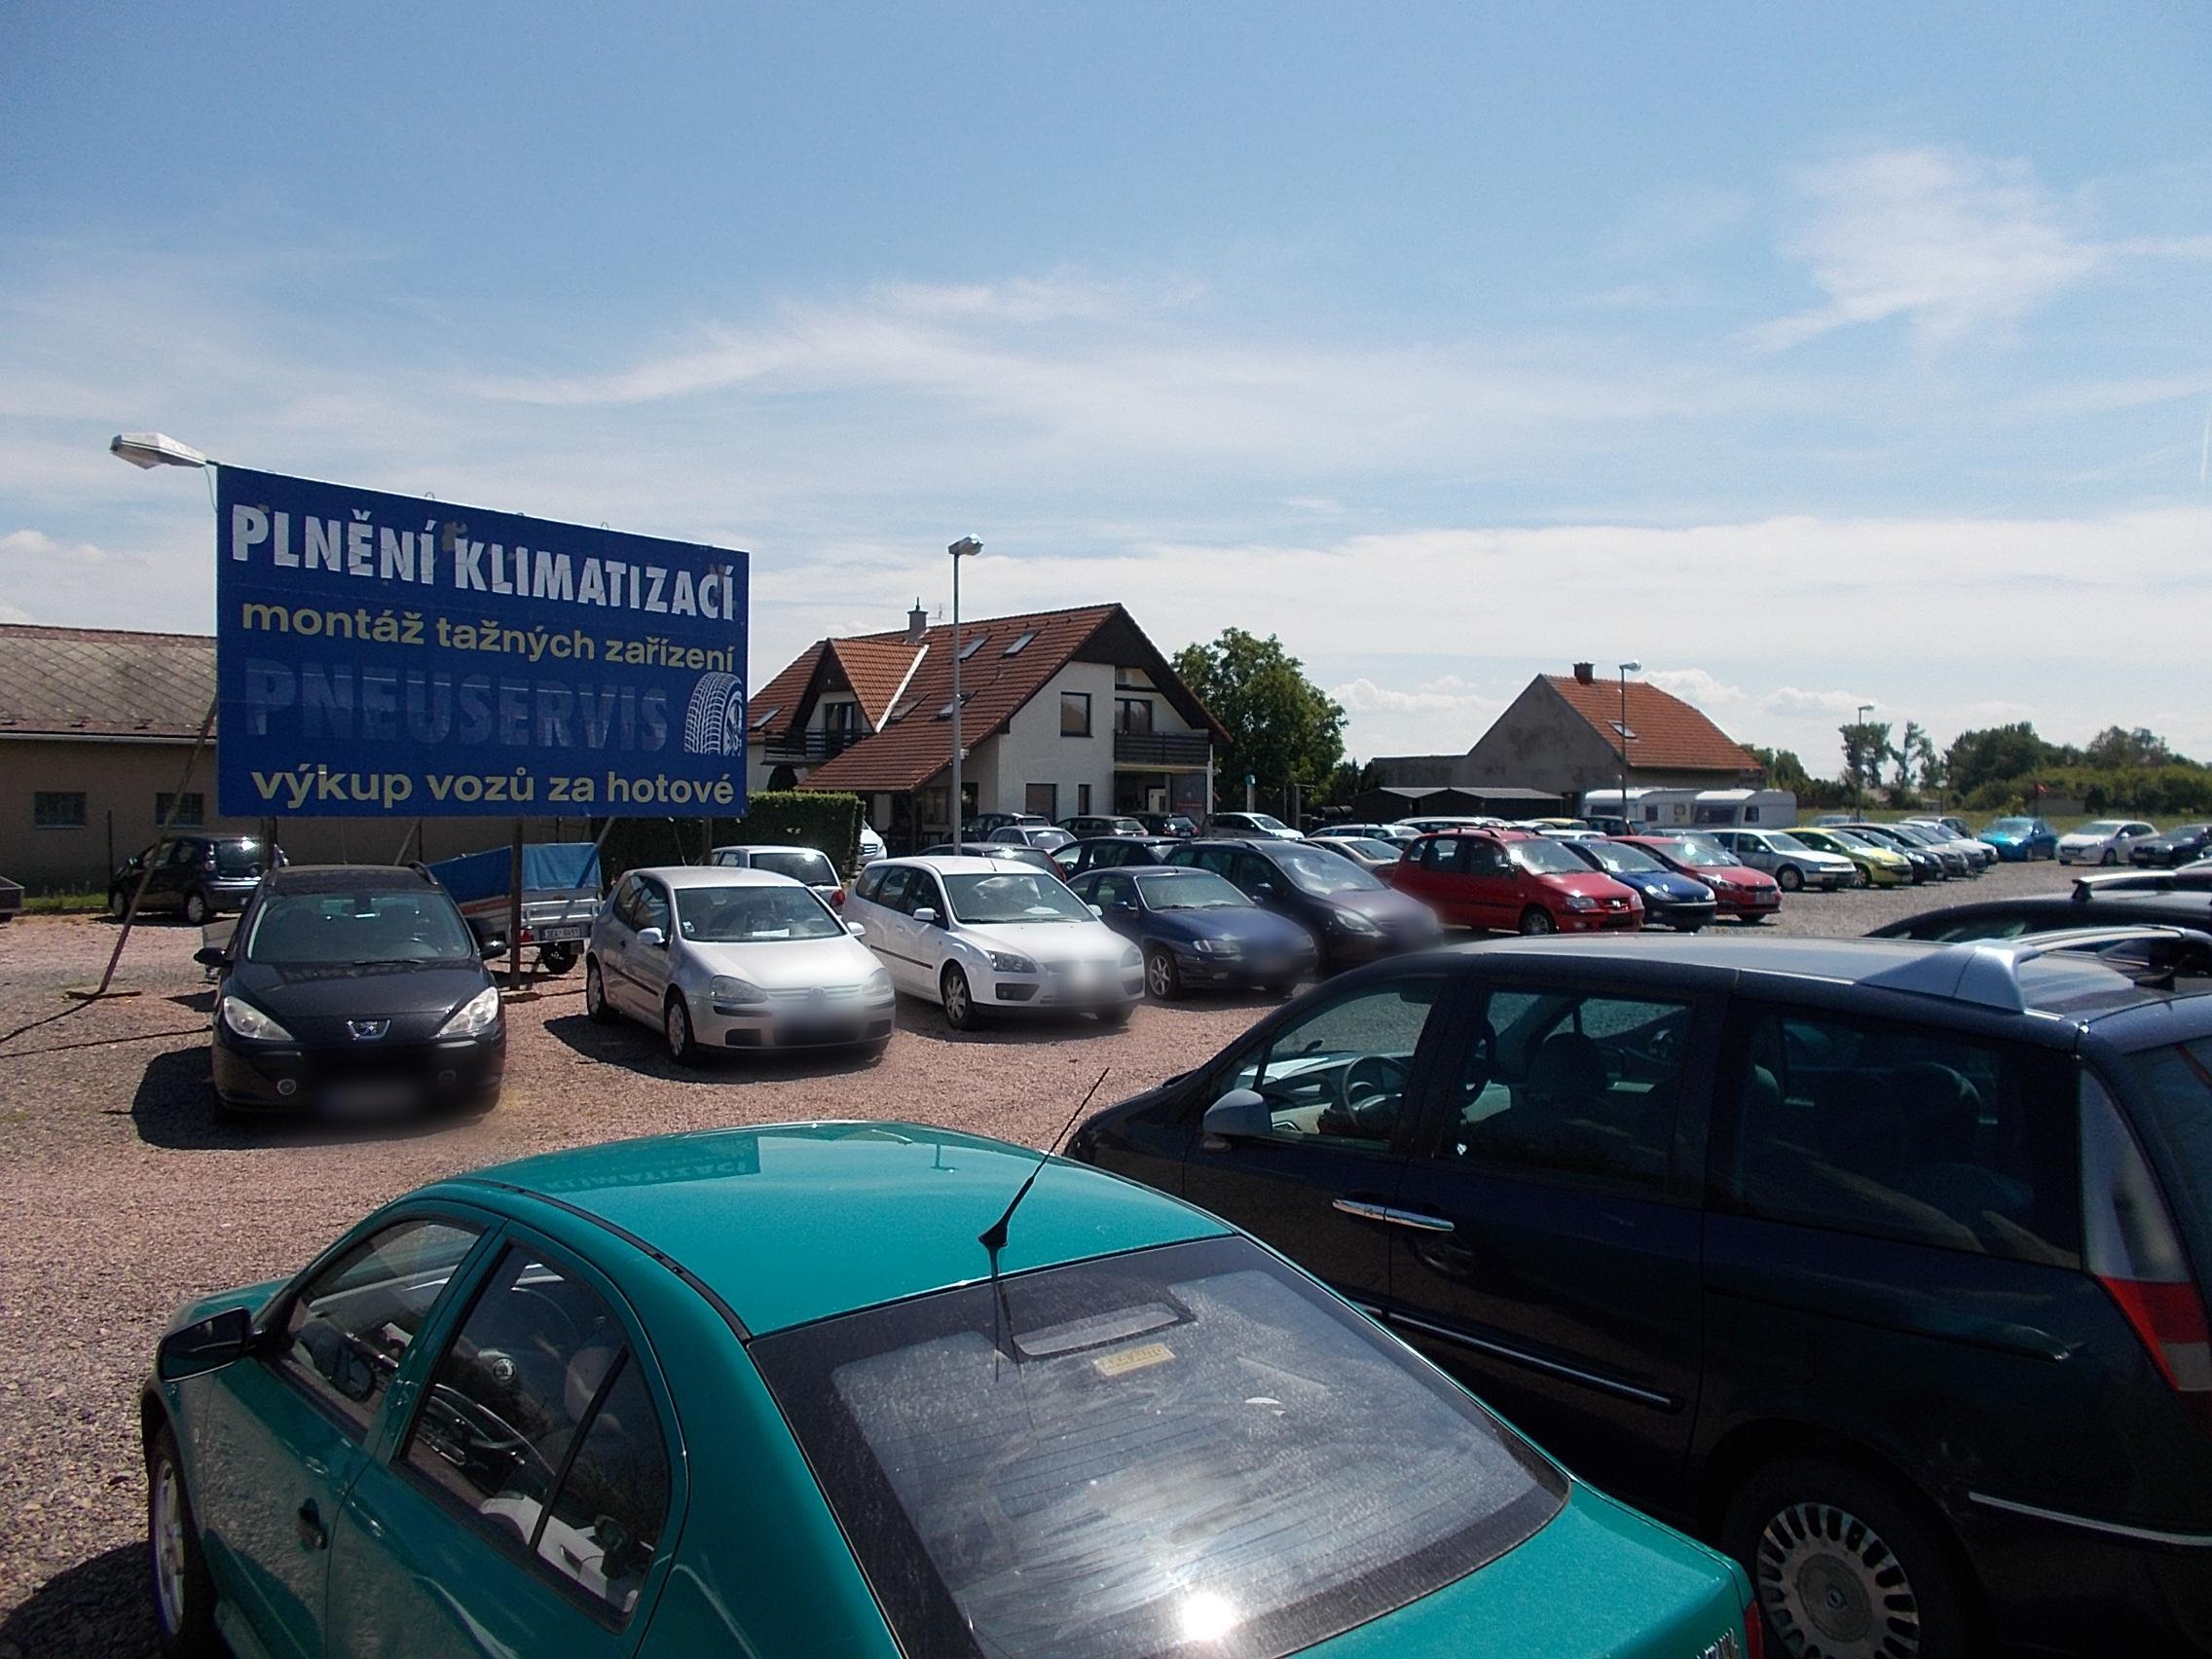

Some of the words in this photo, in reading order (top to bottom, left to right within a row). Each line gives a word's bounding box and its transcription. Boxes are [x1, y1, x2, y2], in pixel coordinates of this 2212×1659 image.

[232, 503, 437, 585] PLNĚNÍ
[454, 537, 735, 620] KLIMATIZACÍ
[242, 603, 425, 645] montáž
[436, 617, 595, 662] tažných
[605, 636, 735, 673] zařízení
[245, 657, 669, 752] PNEUSERVIS
[251, 763, 414, 809] výkup
[426, 766, 535, 801] vozů
[548, 776, 595, 801] za
[608, 771, 735, 803] hotové
